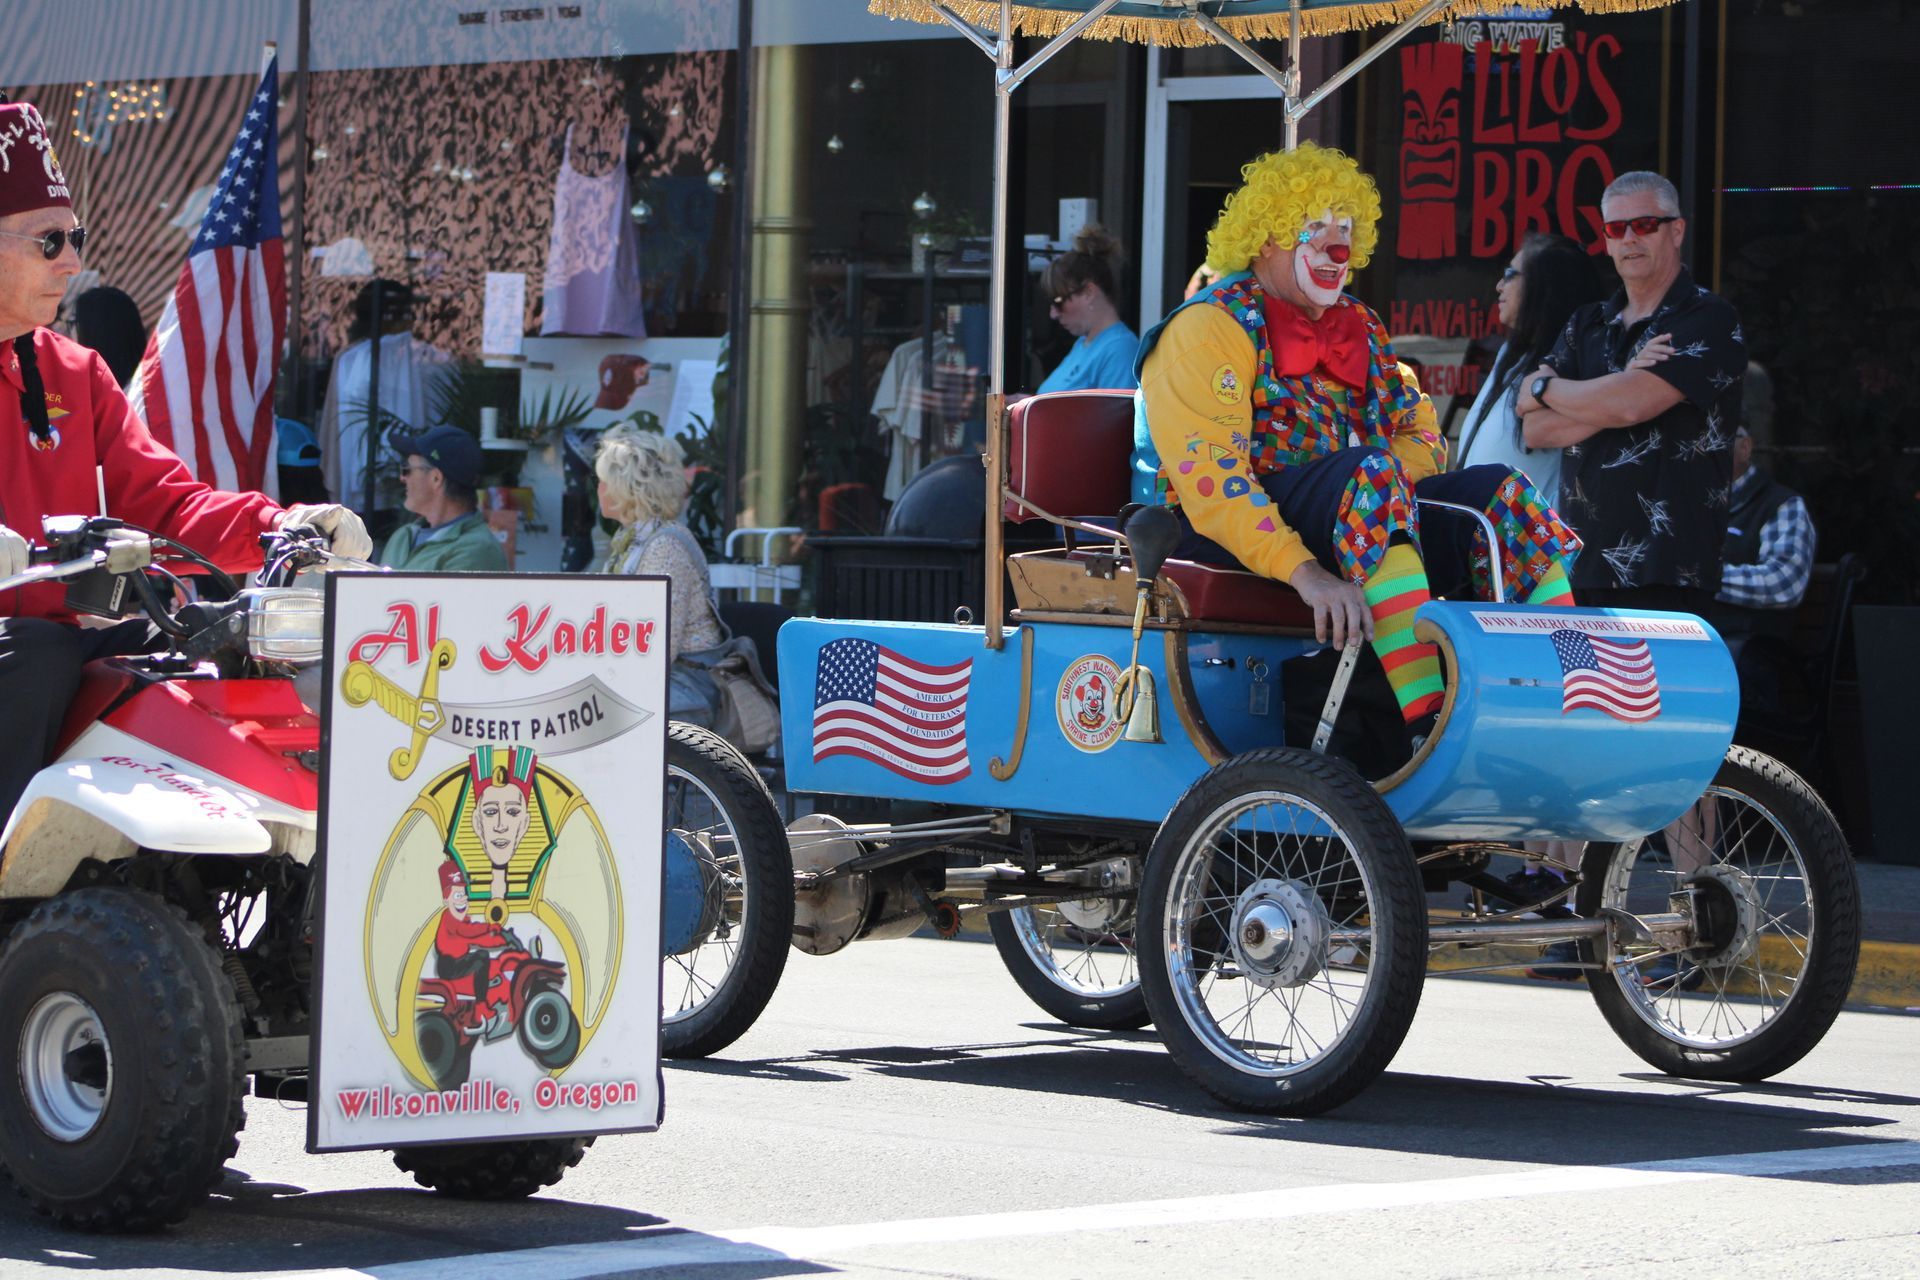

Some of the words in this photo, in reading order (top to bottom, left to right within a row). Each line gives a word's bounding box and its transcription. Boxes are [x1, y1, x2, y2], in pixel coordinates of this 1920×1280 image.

[1489, 21, 1565, 53] WAVE
[1471, 144, 1617, 257] BBQ
[1413, 363, 1480, 397] KEOUT
[346, 600, 441, 666] Al
[478, 602, 656, 673] Kader
[1478, 615, 1703, 636] WWW.AMERICAFORVETERANS.ORG
[1062, 662, 1091, 700] SOUTHWEST
[1093, 661, 1118, 687] WASHIN
[902, 704, 919, 718] FOR
[920, 707, 961, 720] VETERANS
[914, 692, 953, 703] AMERICA
[451, 714, 520, 741] DESERT
[531, 694, 604, 740] PATROL
[906, 724, 955, 738] FOUNDATION
[1065, 719, 1089, 744] SHRINE
[1091, 721, 1119, 744] CLOWNS
[337, 1079, 522, 1121] Wilsonville,
[535, 1078, 638, 1112] Oregon
